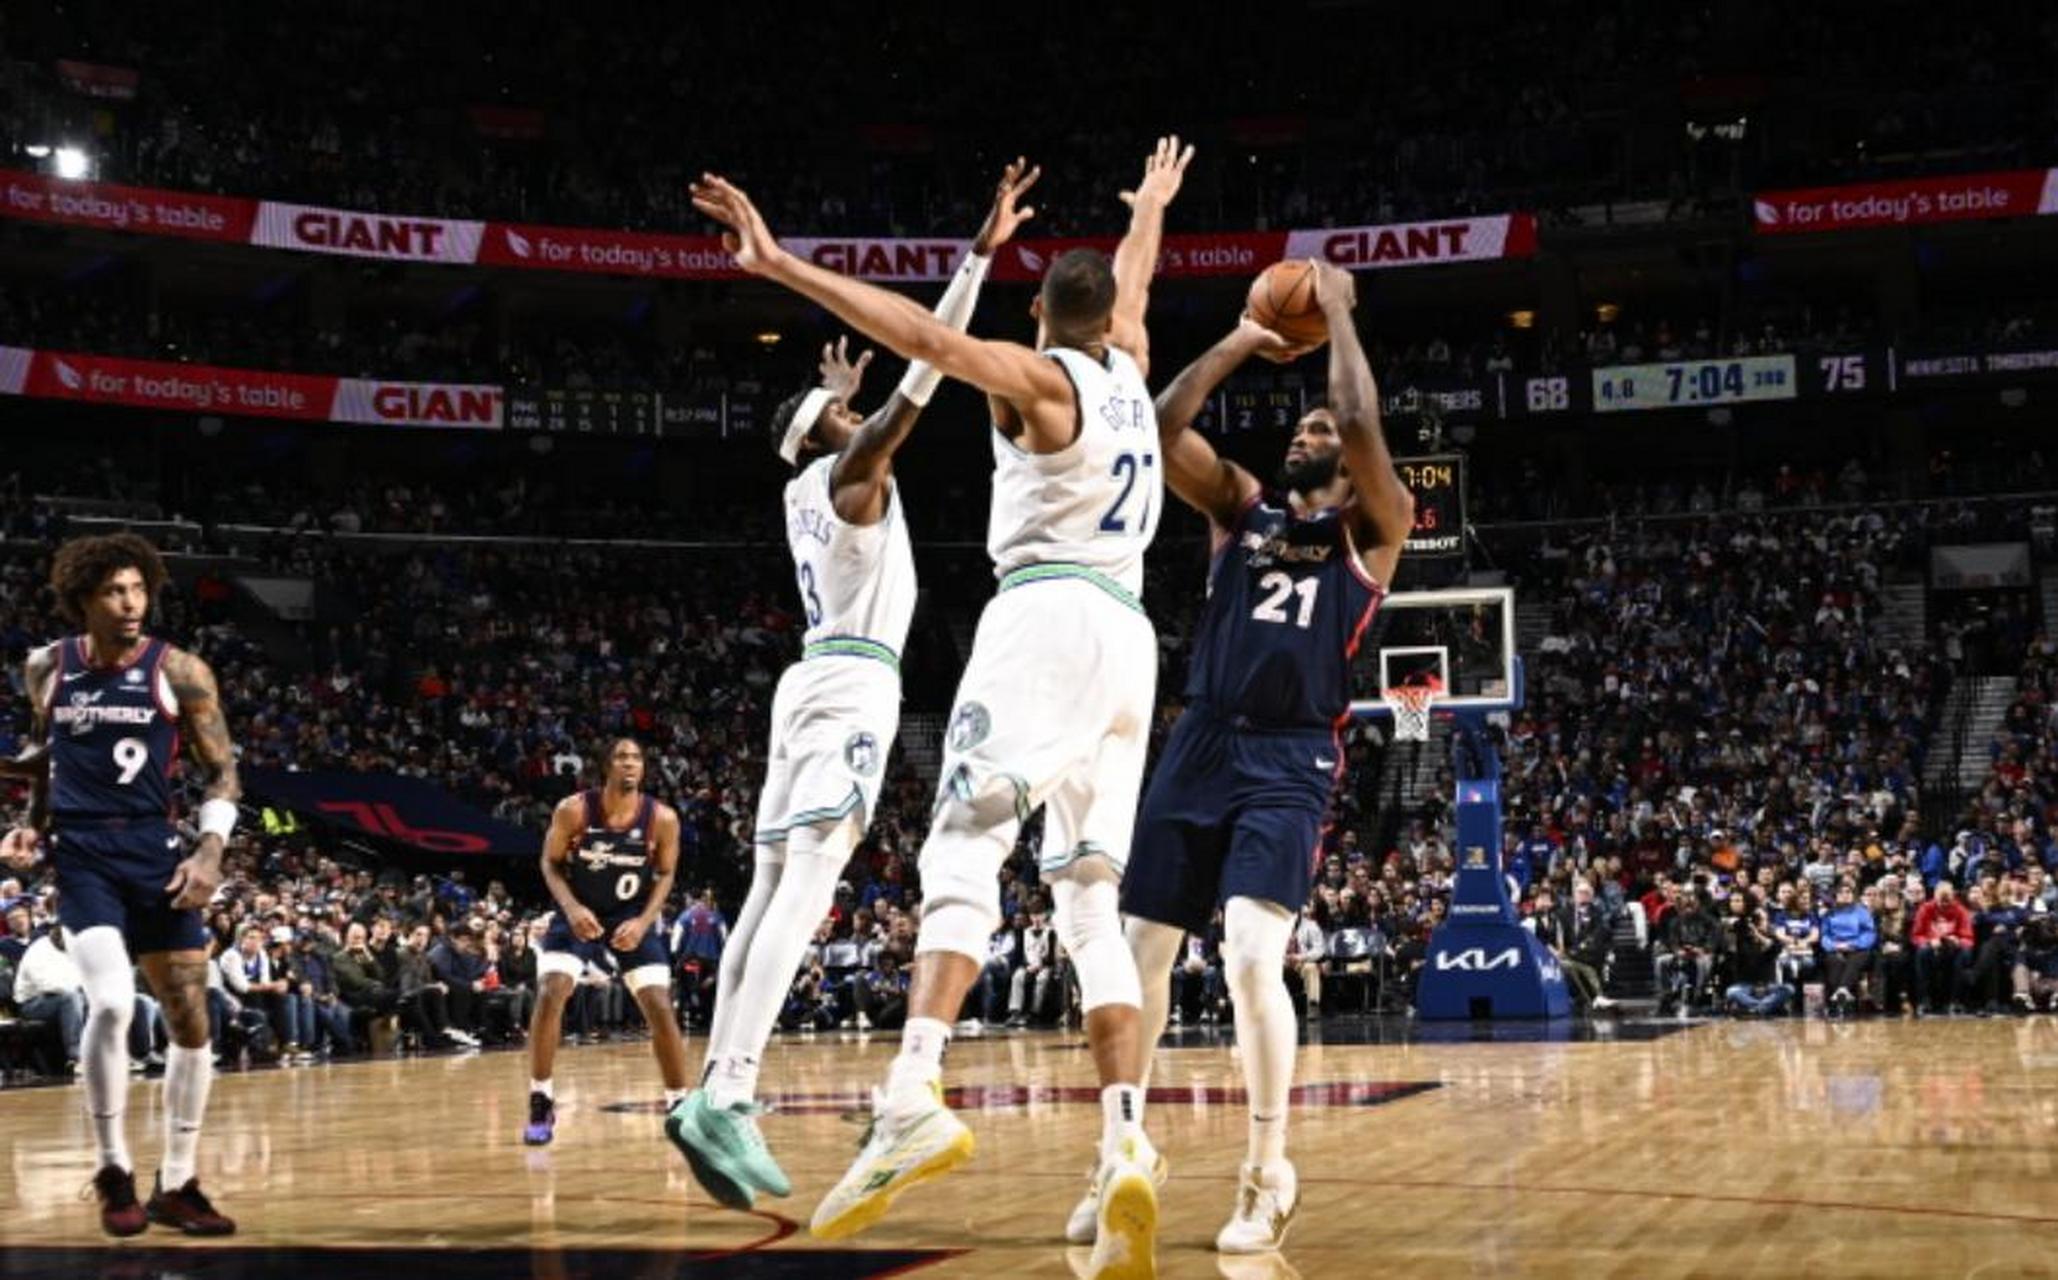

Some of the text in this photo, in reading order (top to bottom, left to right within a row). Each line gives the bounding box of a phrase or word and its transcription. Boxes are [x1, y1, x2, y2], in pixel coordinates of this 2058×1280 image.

[8, 184, 225, 231] for today's table
[1786, 186, 2010, 225] for today's table
[296, 213, 441, 254] GIANT
[1323, 224, 1470, 263] GIANT
[540, 237, 573, 261] for
[580, 244, 672, 271] today's
[812, 244, 957, 275] GIANT
[1188, 245, 1254, 267] table
[89, 370, 306, 410] for today's table
[1665, 363, 1743, 401] 7:04
[1820, 355, 1867, 391] 75
[1526, 376, 1571, 413] 68
[1404, 465, 1452, 489] 7:04
[801, 561, 823, 628] 3
[1252, 571, 1320, 629] 21
[113, 738, 148, 784] 9
[615, 872, 640, 901] 0
